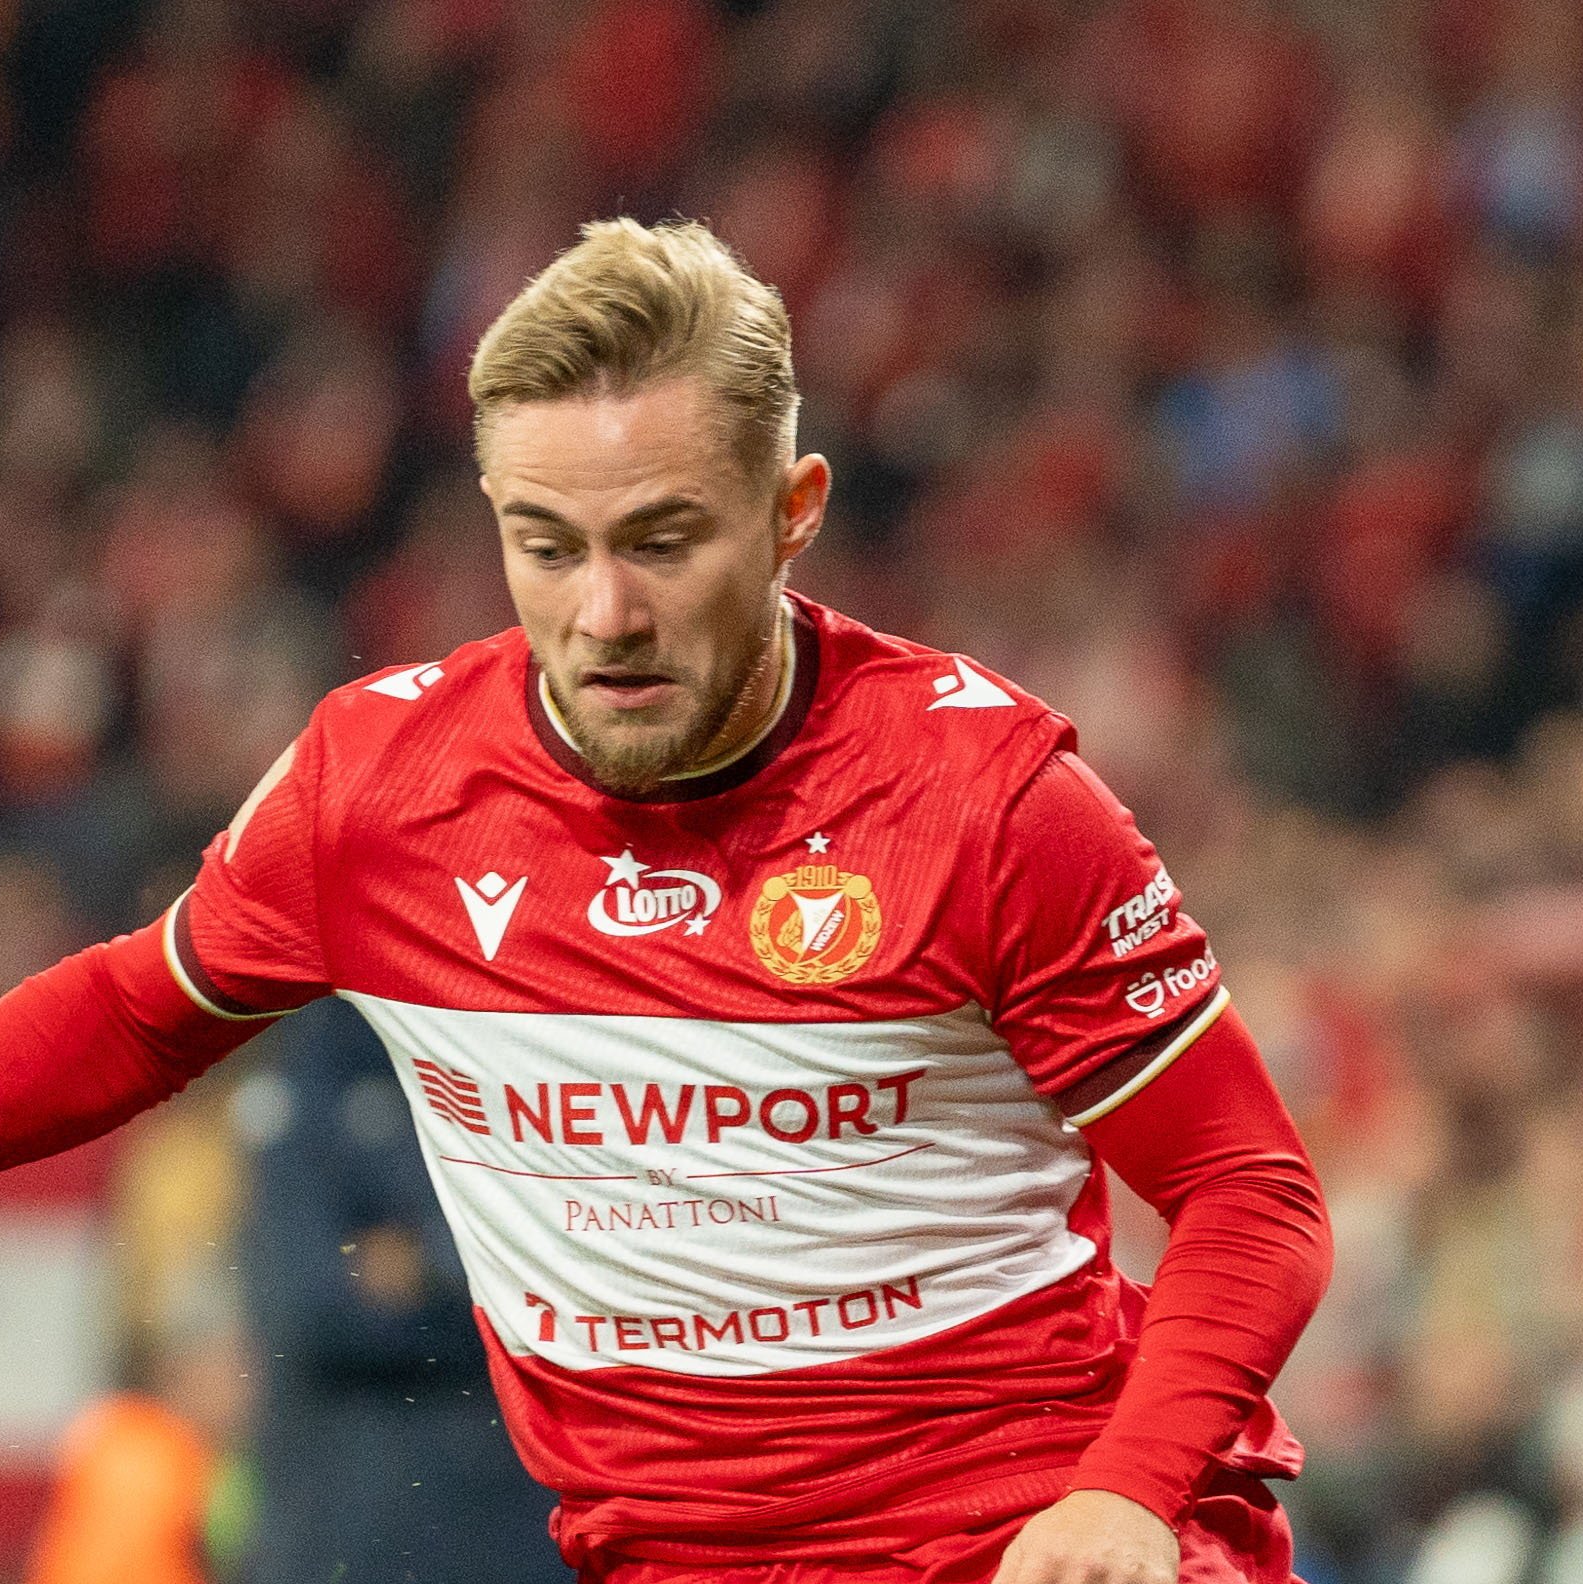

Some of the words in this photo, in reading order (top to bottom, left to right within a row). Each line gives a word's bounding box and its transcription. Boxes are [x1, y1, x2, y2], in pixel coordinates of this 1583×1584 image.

[616, 885, 697, 922] LOTTO
[1112, 907, 1169, 958] INVEST
[504, 1068, 927, 1145] NEWPORT
[647, 1168, 677, 1187] BY
[565, 1195, 780, 1232] PANATTONI
[575, 1276, 923, 1353] TERMOTON
